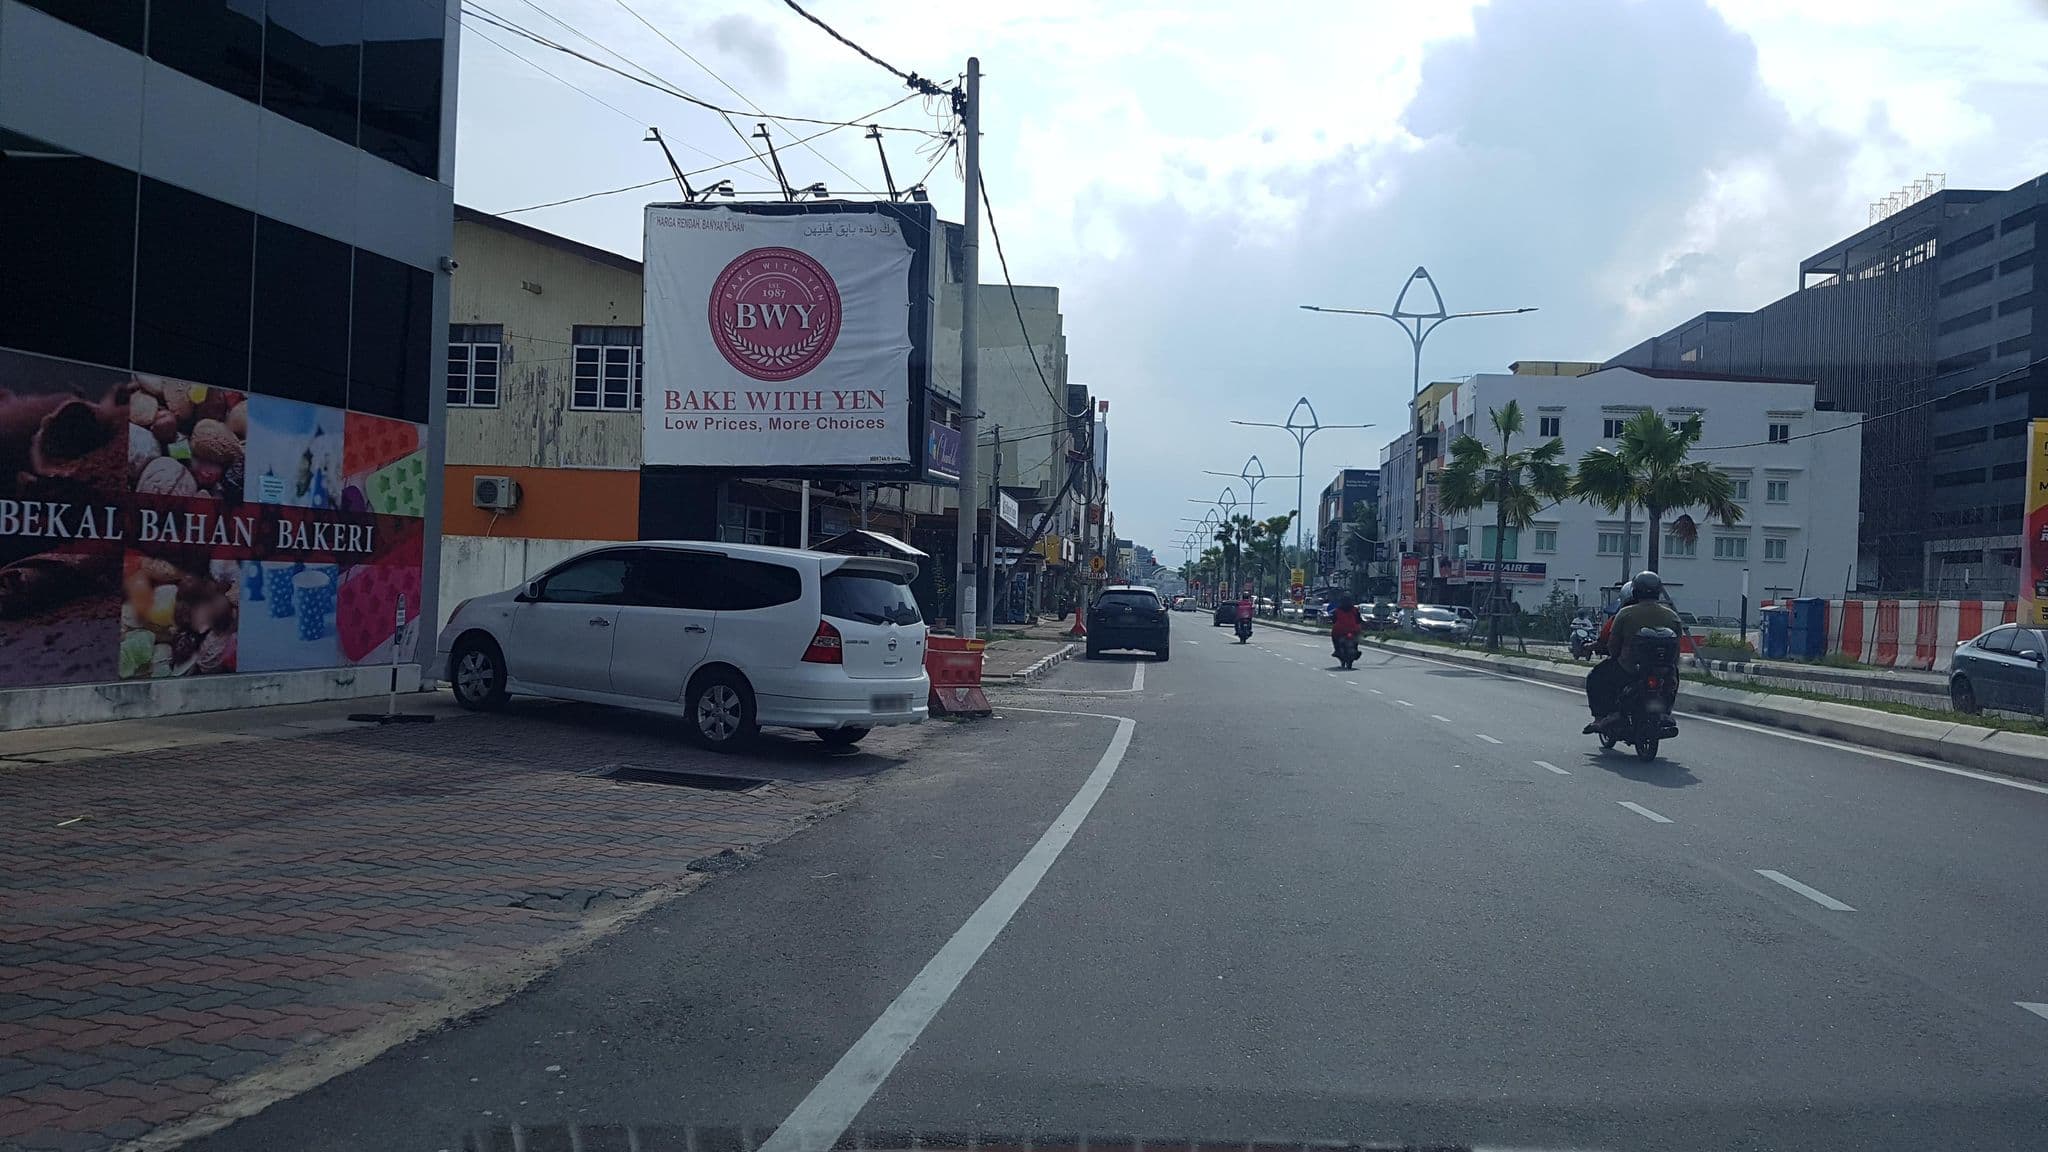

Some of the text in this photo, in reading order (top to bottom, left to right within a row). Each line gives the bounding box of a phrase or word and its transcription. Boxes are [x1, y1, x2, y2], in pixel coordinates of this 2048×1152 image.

[656, 216, 676, 228] HARGA
[677, 217, 700, 230] RENDAH
[762, 262, 799, 274] WITH
[807, 277, 825, 301] YEN
[762, 288, 786, 299] 1987
[736, 303, 817, 329] BWY
[664, 389, 886, 411] BAKE WITH YEN
[665, 416, 885, 433] Low Prices, More Choices
[0, 499, 374, 553] BEKAL BAHAN BAKERI
[1481, 562, 1530, 572] TOAIRE
